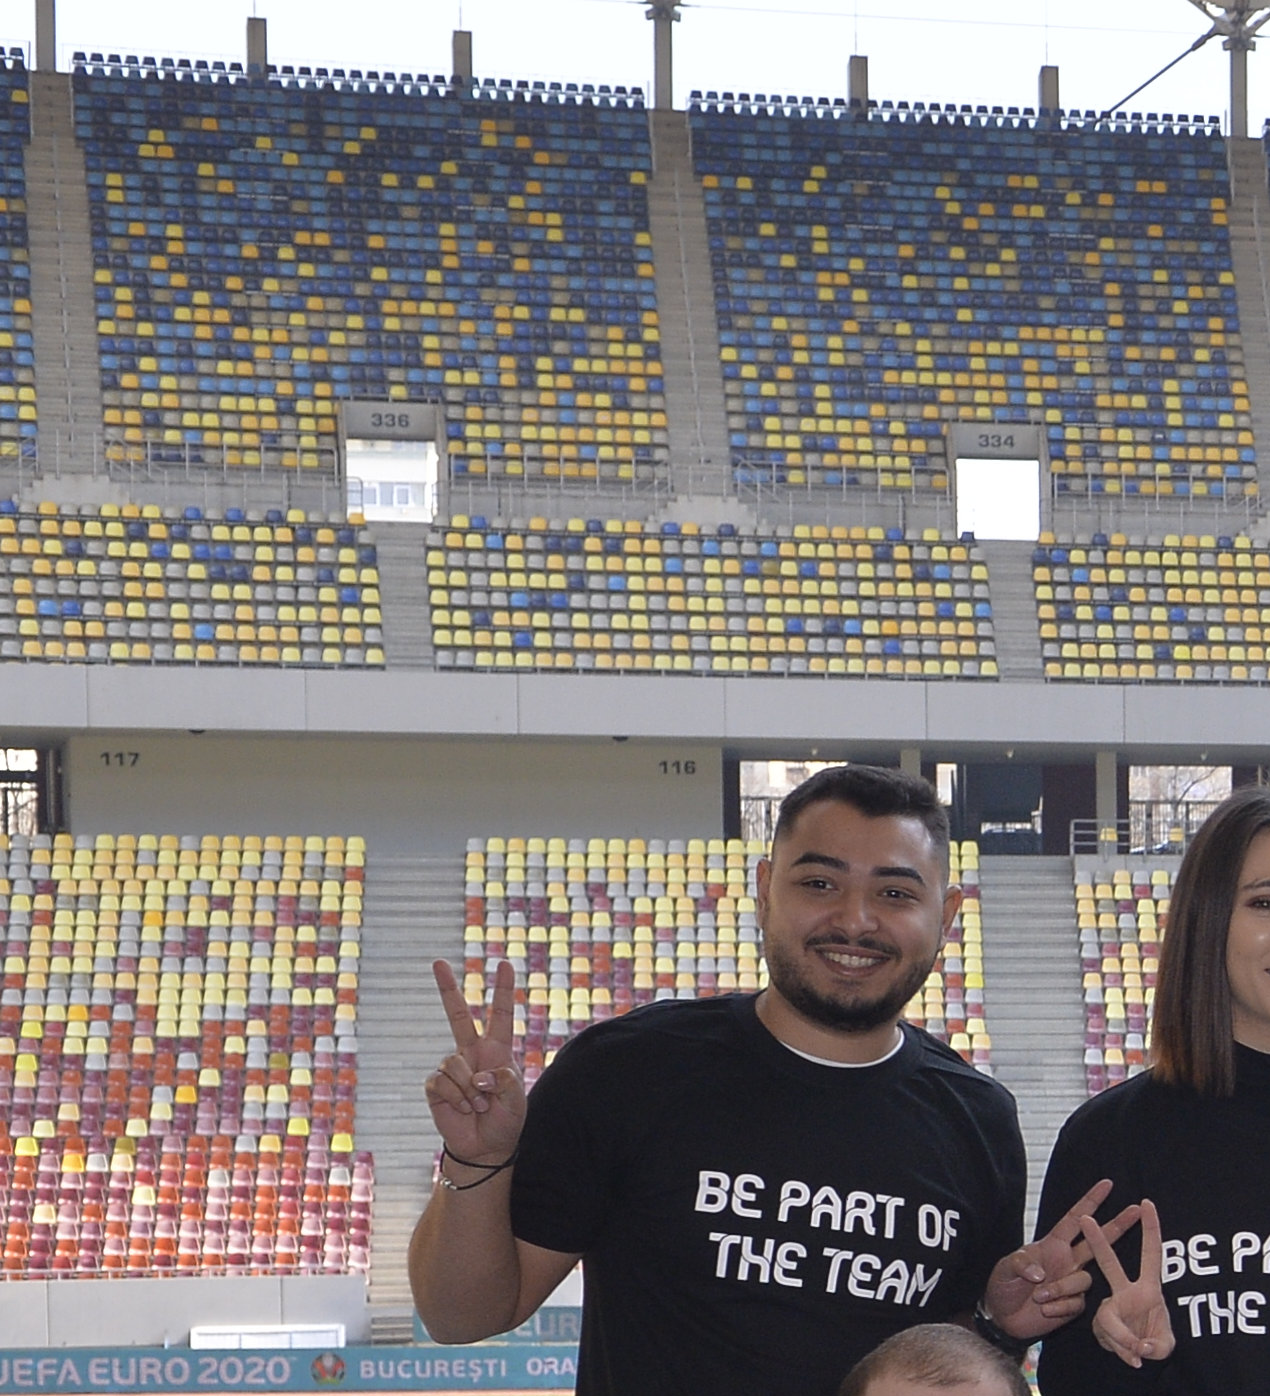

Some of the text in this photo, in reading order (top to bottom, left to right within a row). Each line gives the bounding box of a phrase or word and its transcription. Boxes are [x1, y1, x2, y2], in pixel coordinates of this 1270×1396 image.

[371, 413, 410, 427] 336
[977, 434, 1015, 448] 334
[100, 751, 140, 766] 117
[658, 760, 696, 775] 116
[695, 1170, 960, 1251] BE PART OF
[709, 1231, 943, 1308] THE TEAM
[1161, 1233, 1220, 1284] BE
[1177, 1290, 1266, 1337] THE
[89, 1357, 191, 1386] EURO
[197, 1355, 291, 1385] 2020
